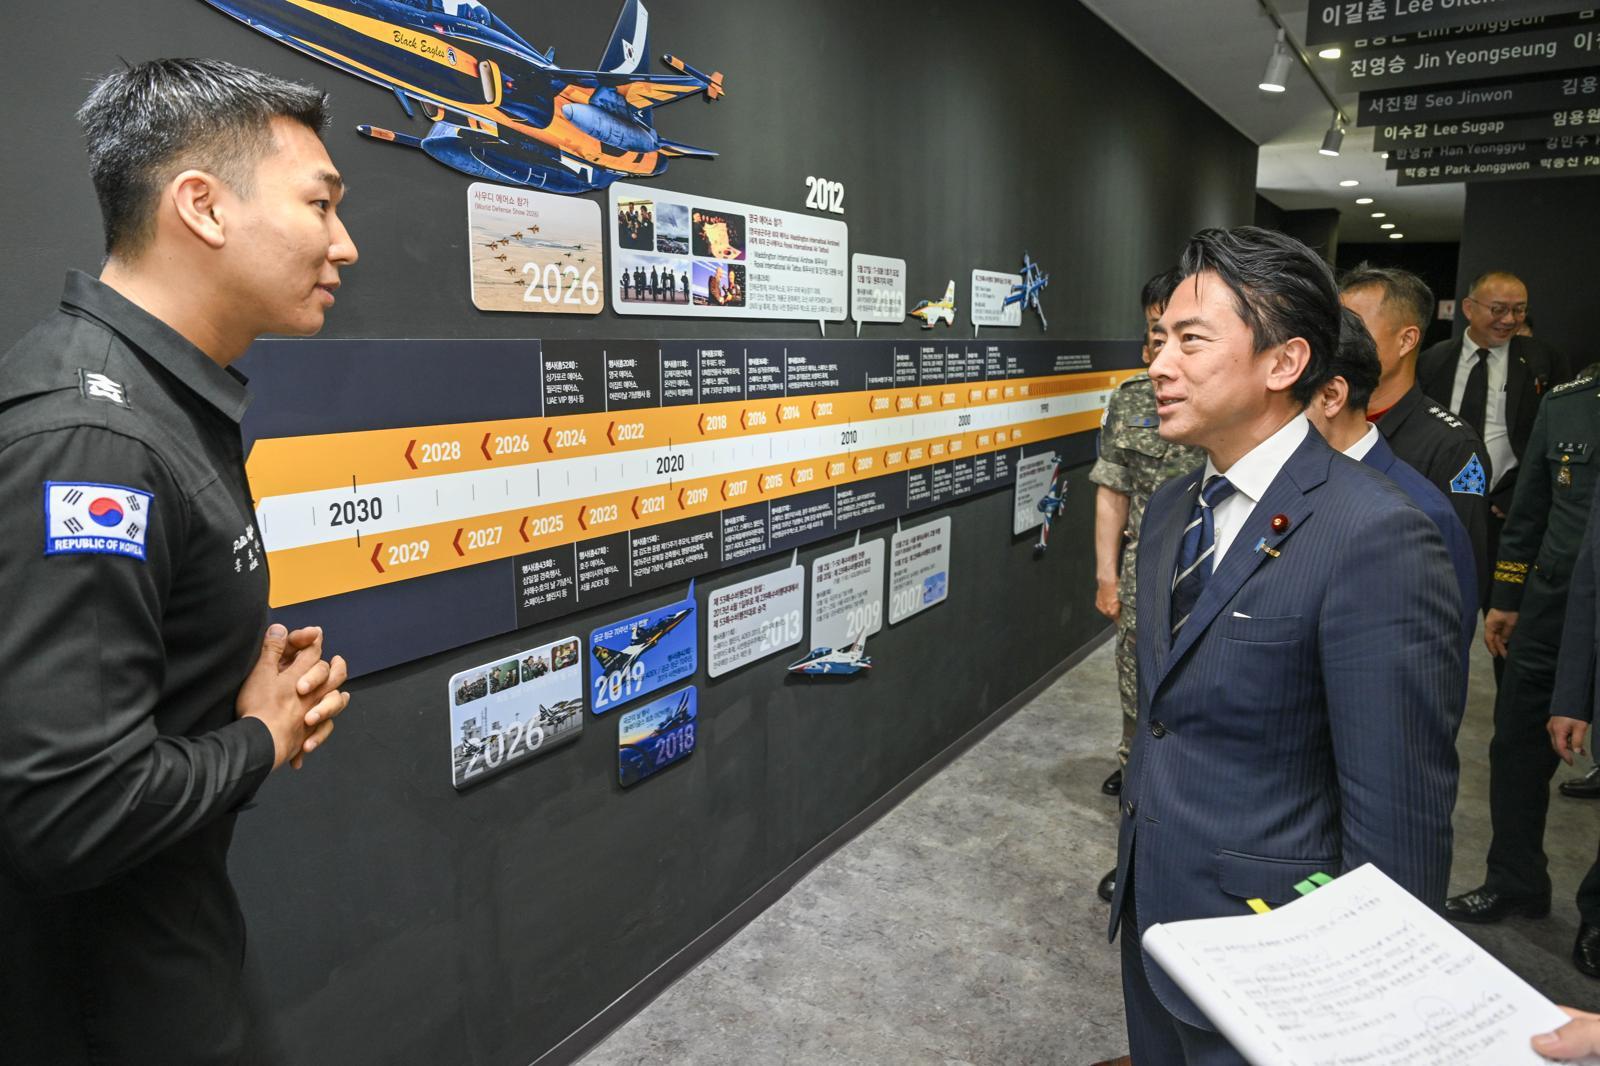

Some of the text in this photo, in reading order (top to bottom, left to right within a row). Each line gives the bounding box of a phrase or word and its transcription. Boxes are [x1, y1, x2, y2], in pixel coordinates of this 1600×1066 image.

[1322, 1, 1387, 27] 이길춘
[393, 30, 445, 58] Black Eagles
[1574, 32, 1600, 51] 이
[1350, 41, 1557, 78] 진영승 Jin Yeongseung
[1369, 87, 1513, 113] 서진원 Seo Jinwon
[1384, 121, 1504, 140] 이수갑 Lee Sugap
[1440, 146, 1463, 156] Han
[1445, 164, 1470, 175] Park
[475, 191, 529, 208] 사우디 에어쇼 참가
[805, 176, 844, 214] 2012
[522, 262, 599, 306] 2026
[546, 373, 567, 382] 싱가포르
[547, 397, 558, 405] UAE
[558, 395, 567, 403] VIP
[421, 441, 461, 464] 2028
[495, 434, 530, 455] 2026
[556, 428, 587, 448] 2024
[618, 423, 645, 441] 2022
[706, 415, 727, 431] 2018
[748, 411, 767, 426] 2016
[783, 406, 800, 419] 2014
[817, 402, 833, 416] 2012
[329, 497, 383, 527] 2030
[656, 454, 685, 475] 2020
[841, 430, 858, 446] 2010
[958, 414, 971, 428] 2000
[388, 540, 430, 566] 2029
[467, 526, 503, 549] 2027
[532, 514, 564, 537] 2025
[589, 504, 618, 525] 2023
[641, 496, 665, 514] 2021
[687, 488, 708, 505] 2019
[729, 480, 748, 496] 2017
[764, 473, 783, 489] 2015
[797, 468, 814, 483] 2013
[831, 462, 846, 476] 2011
[55, 538, 142, 556] REPUBLIC OF KOREA
[591, 579, 604, 589] ADEX
[892, 583, 922, 619] 2007
[760, 609, 800, 652] 2013
[846, 600, 880, 638] 2009
[594, 661, 646, 709] 2019
[464, 716, 545, 780] 2026
[655, 724, 694, 765] 2018
